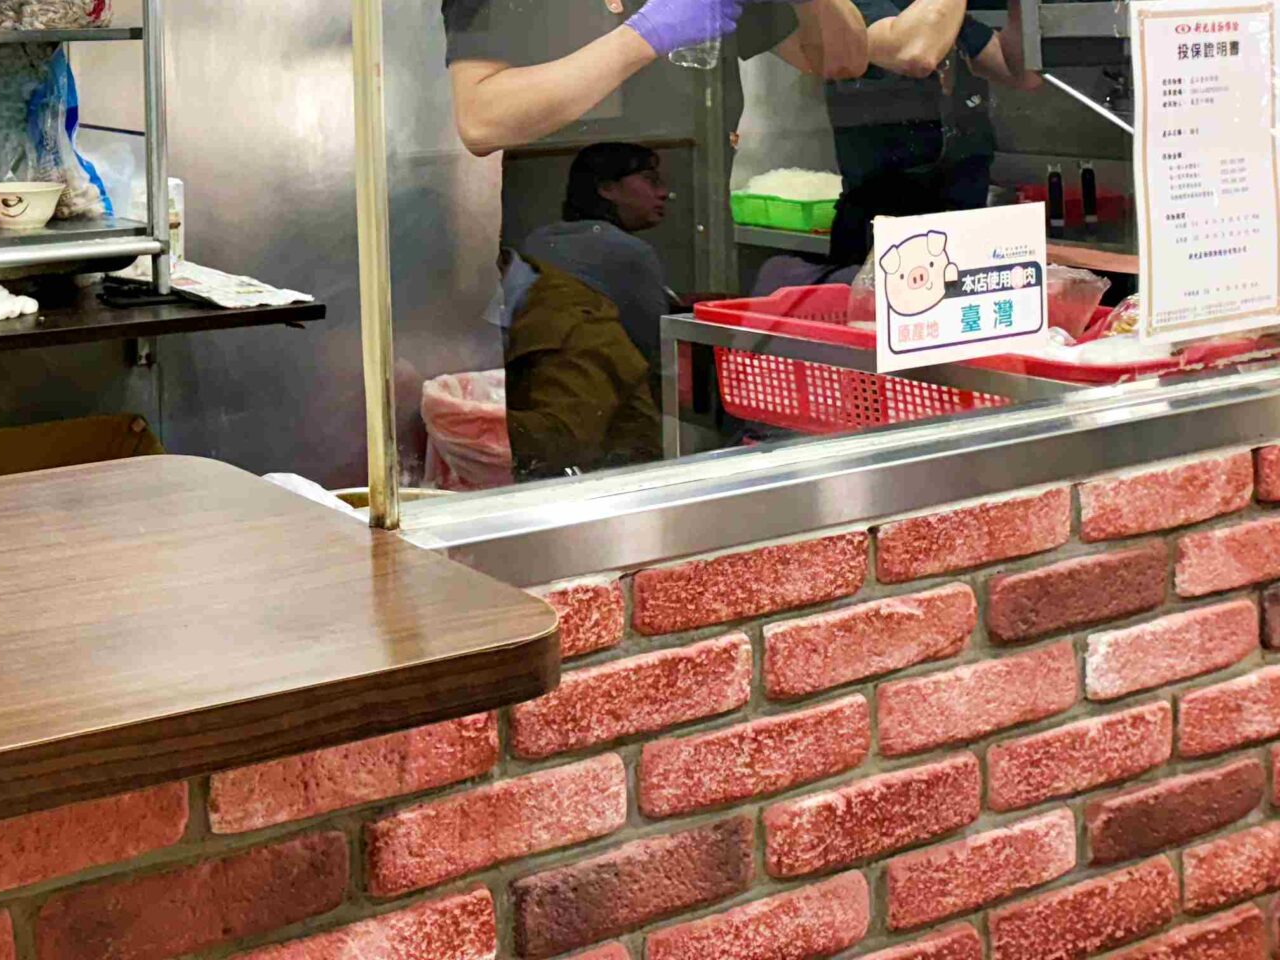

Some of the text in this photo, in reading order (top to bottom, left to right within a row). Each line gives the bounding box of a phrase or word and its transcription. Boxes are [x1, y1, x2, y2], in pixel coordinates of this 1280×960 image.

[961, 267, 1036, 293] 本店使用肉
[959, 298, 1014, 334] 臺灣
[897, 320, 940, 343] 原產地
